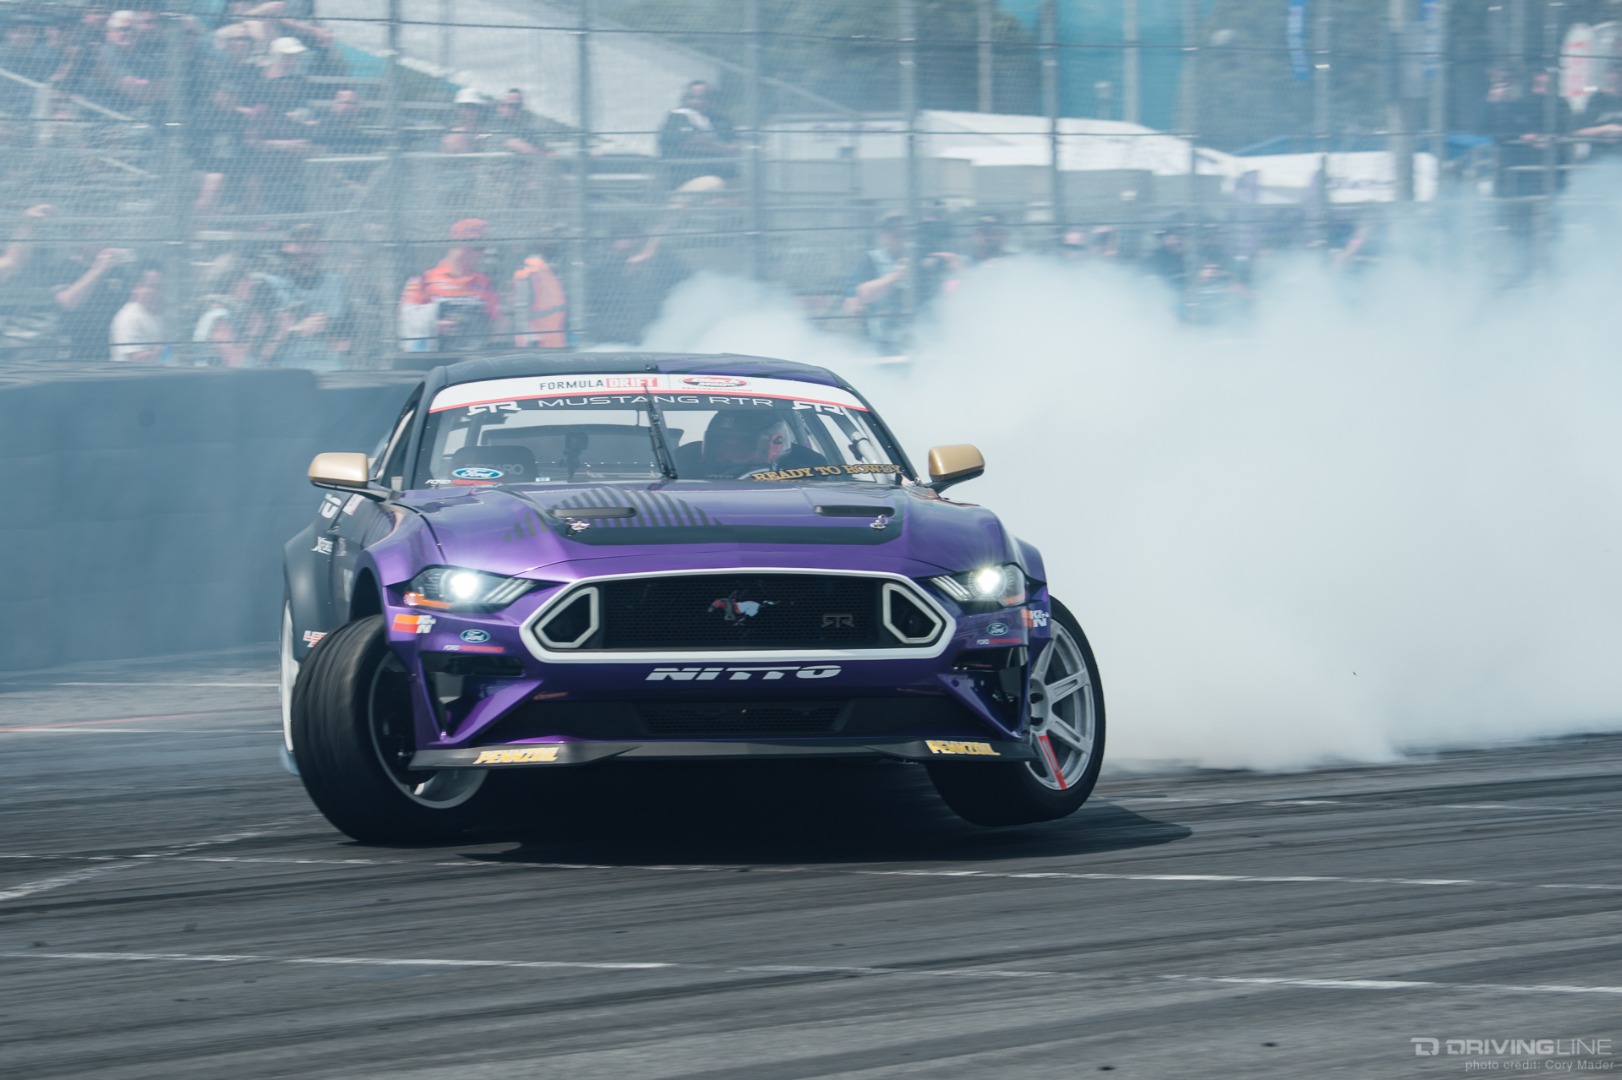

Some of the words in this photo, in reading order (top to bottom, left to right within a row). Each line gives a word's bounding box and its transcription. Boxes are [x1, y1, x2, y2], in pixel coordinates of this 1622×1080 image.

[540, 378, 604, 391] FORMULA
[607, 377, 656, 388] DRIFT
[467, 401, 522, 416] RTR
[538, 395, 700, 408] MUSTANG
[708, 395, 774, 407] RTR
[792, 400, 845, 416] RTR
[458, 468, 498, 479] Ford
[751, 466, 815, 481] READY
[815, 465, 843, 477] TO
[842, 463, 903, 475] ROWDY
[645, 665, 842, 680] NITTO
[925, 739, 1001, 756] PENNZOIL
[473, 747, 560, 765] PENNZOIL
